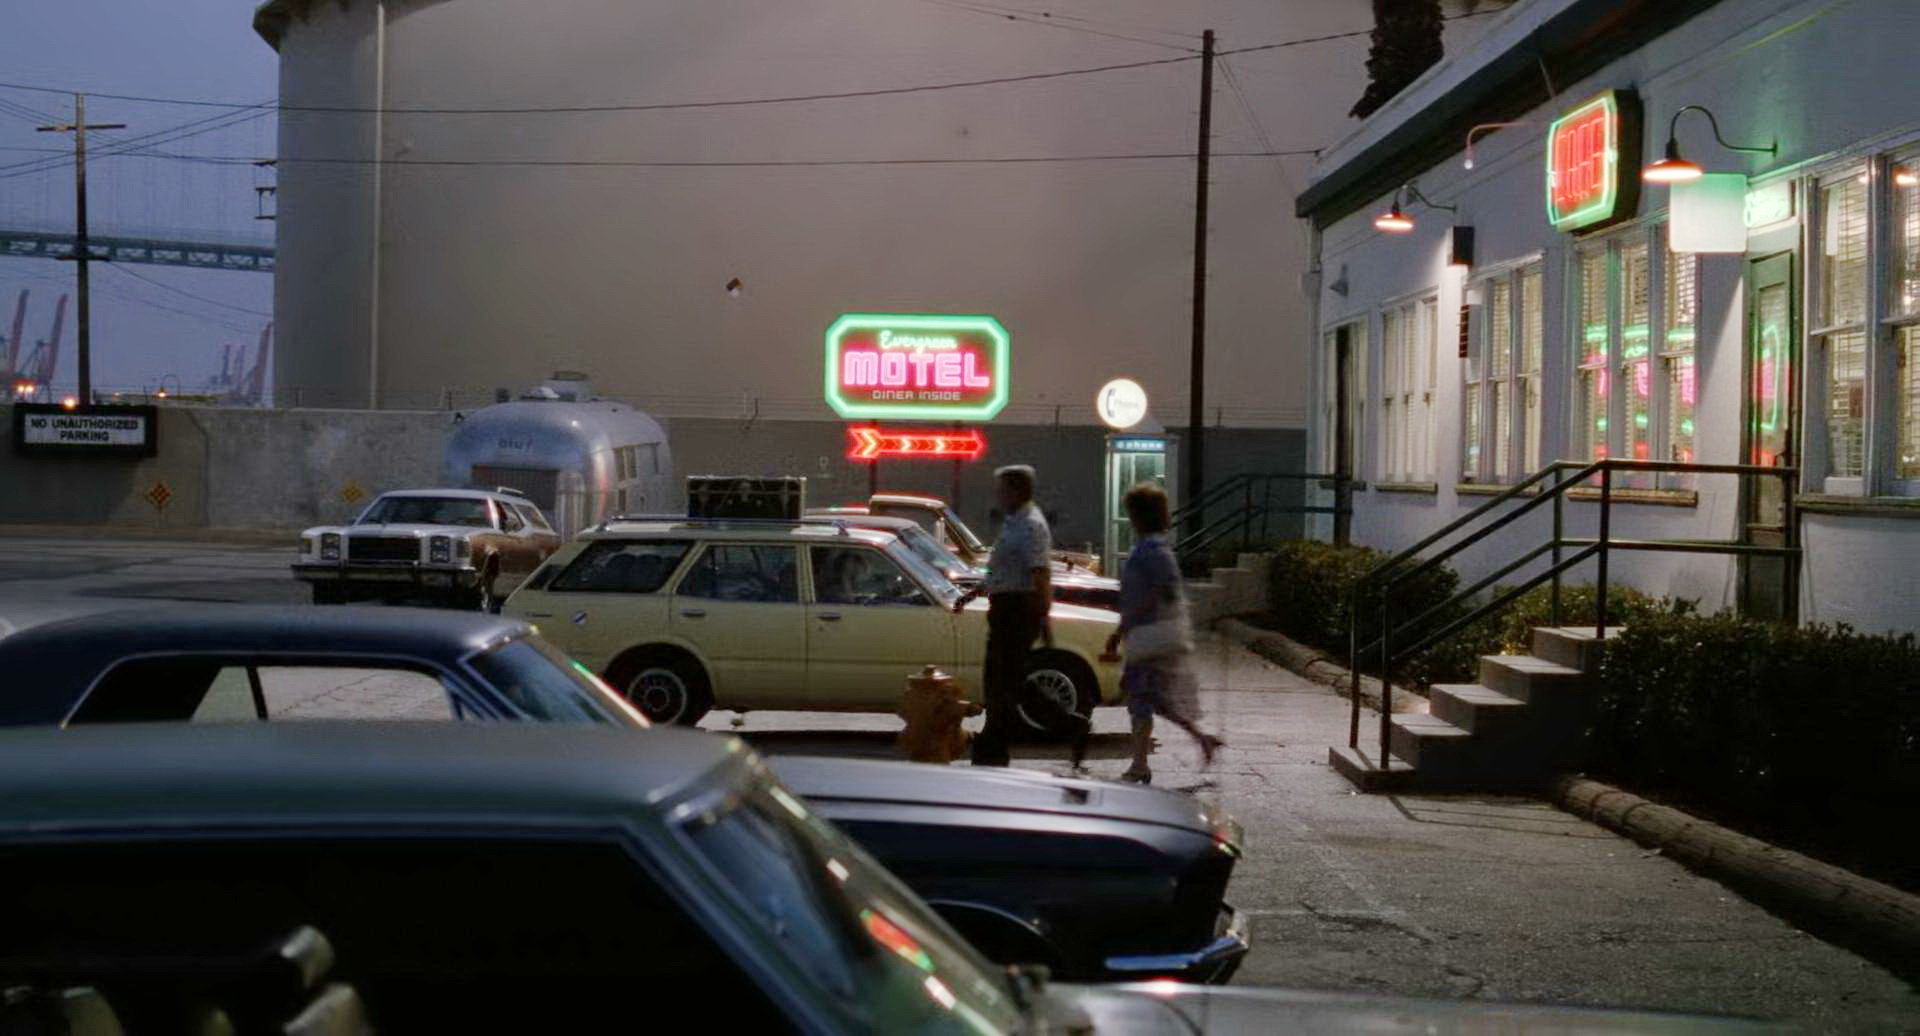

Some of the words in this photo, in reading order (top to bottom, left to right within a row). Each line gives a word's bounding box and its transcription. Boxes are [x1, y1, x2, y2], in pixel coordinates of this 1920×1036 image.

[880, 329, 958, 354] Evergreen
[844, 351, 990, 387] MOTEL
[872, 390, 915, 400] DINER
[919, 390, 961, 401] INSIDE
[31, 418, 47, 429] NO
[51, 418, 138, 430] UNAUTHORIZED
[60, 430, 110, 441] PARKING
